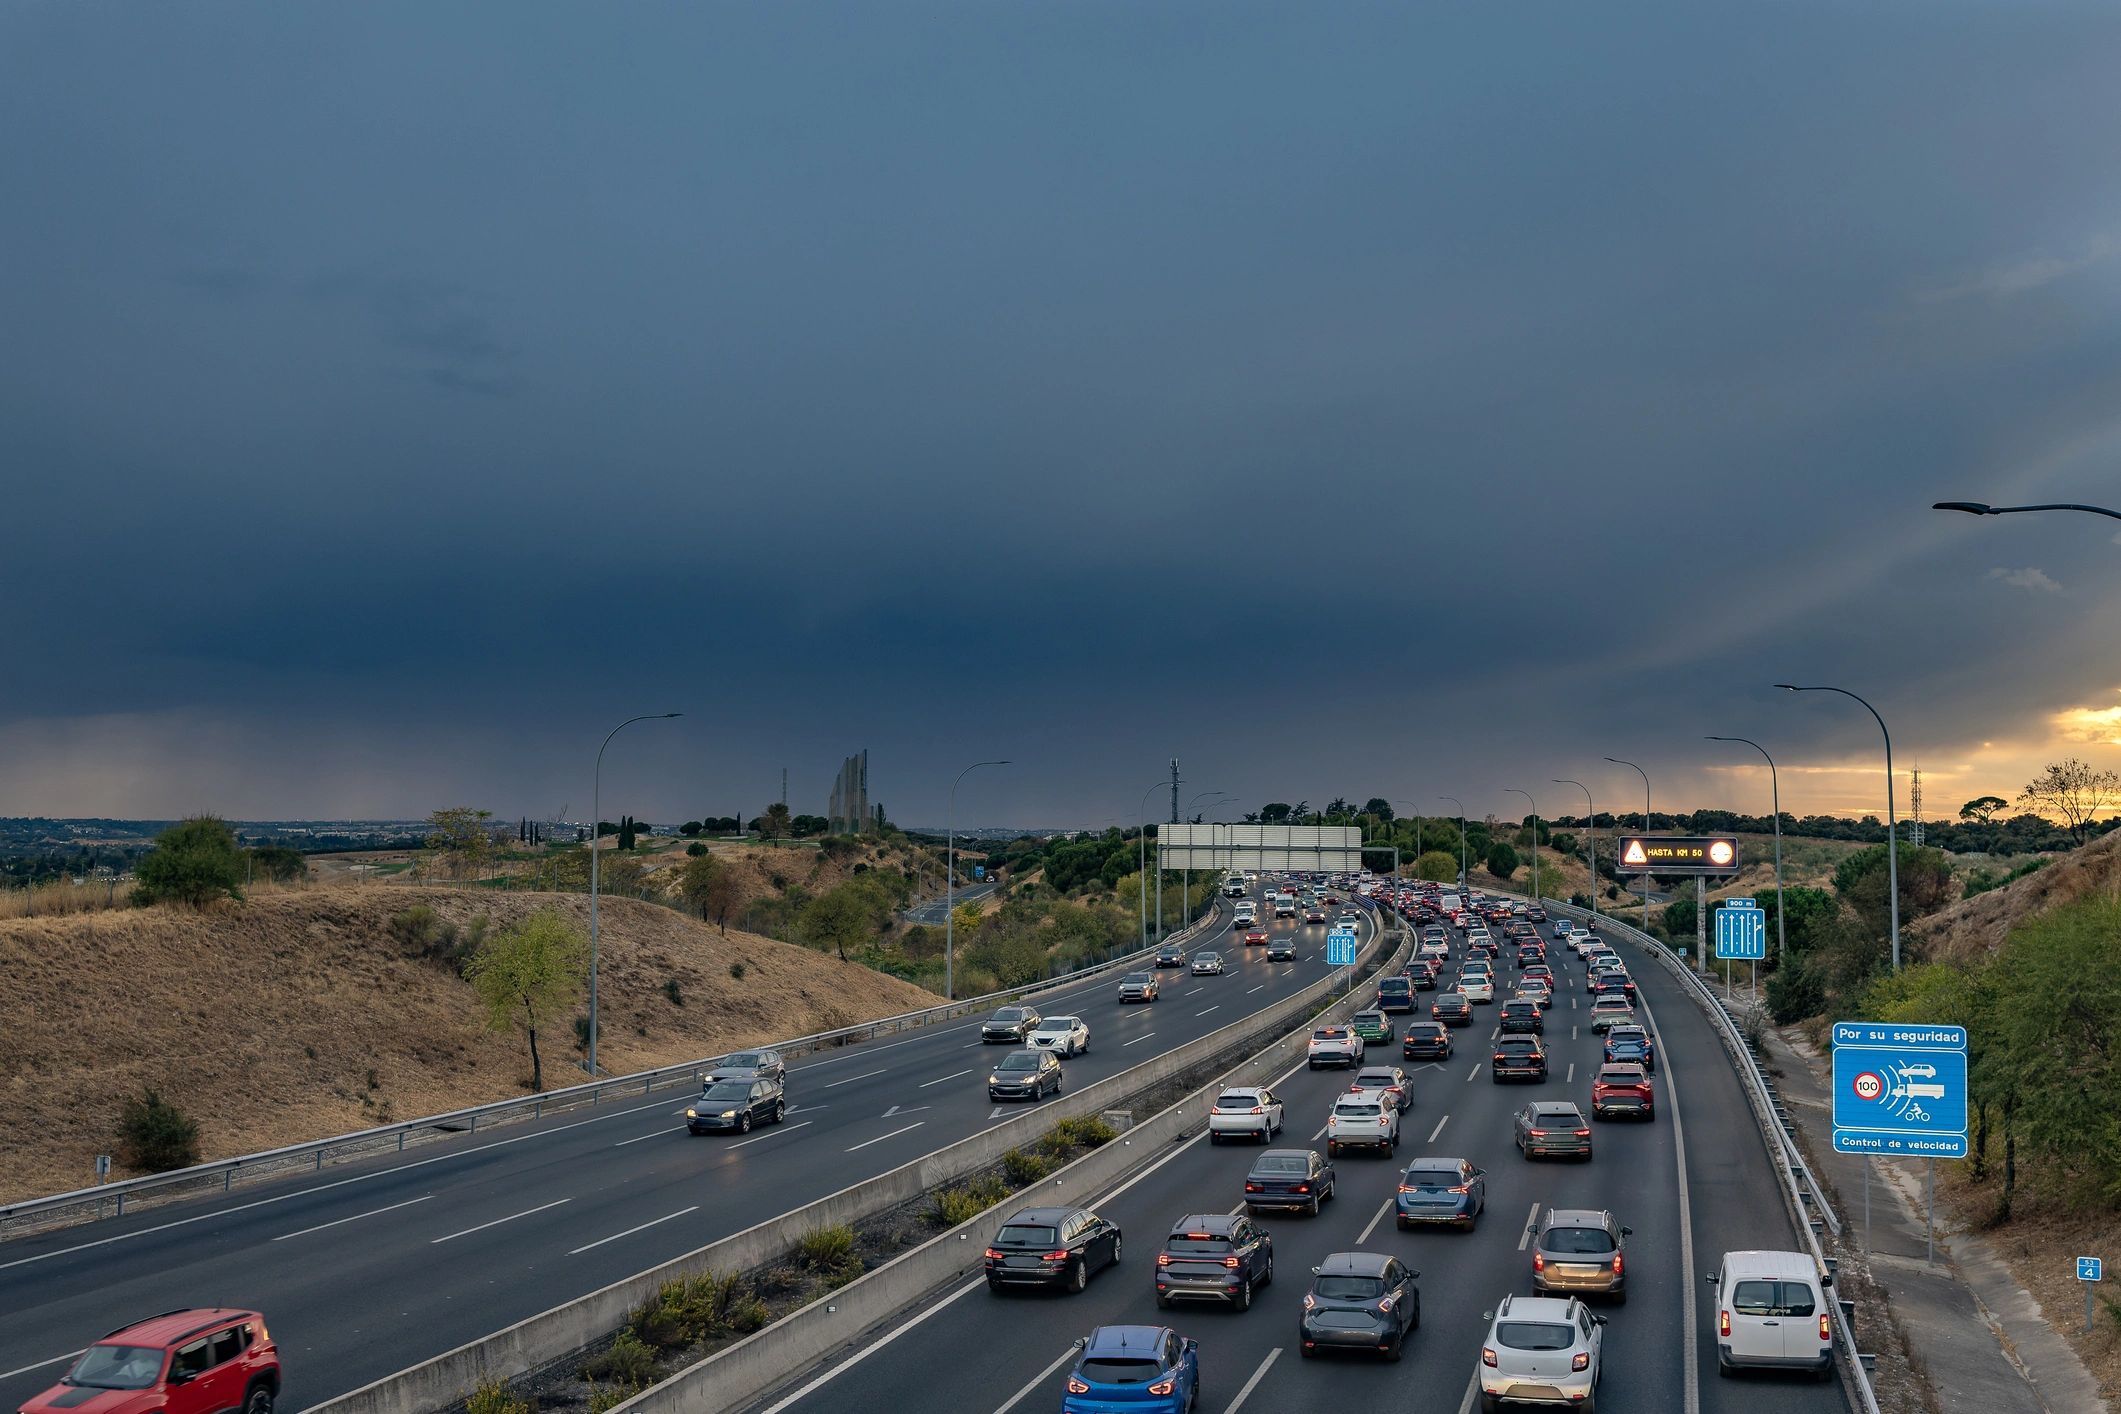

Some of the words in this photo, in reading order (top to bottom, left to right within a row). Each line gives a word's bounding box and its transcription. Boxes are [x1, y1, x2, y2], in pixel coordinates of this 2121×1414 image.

[1647, 848, 1673, 856] HASTA
[1677, 849, 1688, 857] KM
[1692, 849, 1703, 857] 50
[1840, 1028, 1861, 1040] Por
[1869, 1031, 1885, 1040] su
[1893, 1030, 1960, 1043] seguridad
[1858, 1081, 1878, 1091] 100
[1841, 1137, 1882, 1148] Control
[1888, 1138, 1901, 1148] de
[1908, 1140, 1959, 1151] velocidad
[2084, 1267, 2094, 1278] 4
